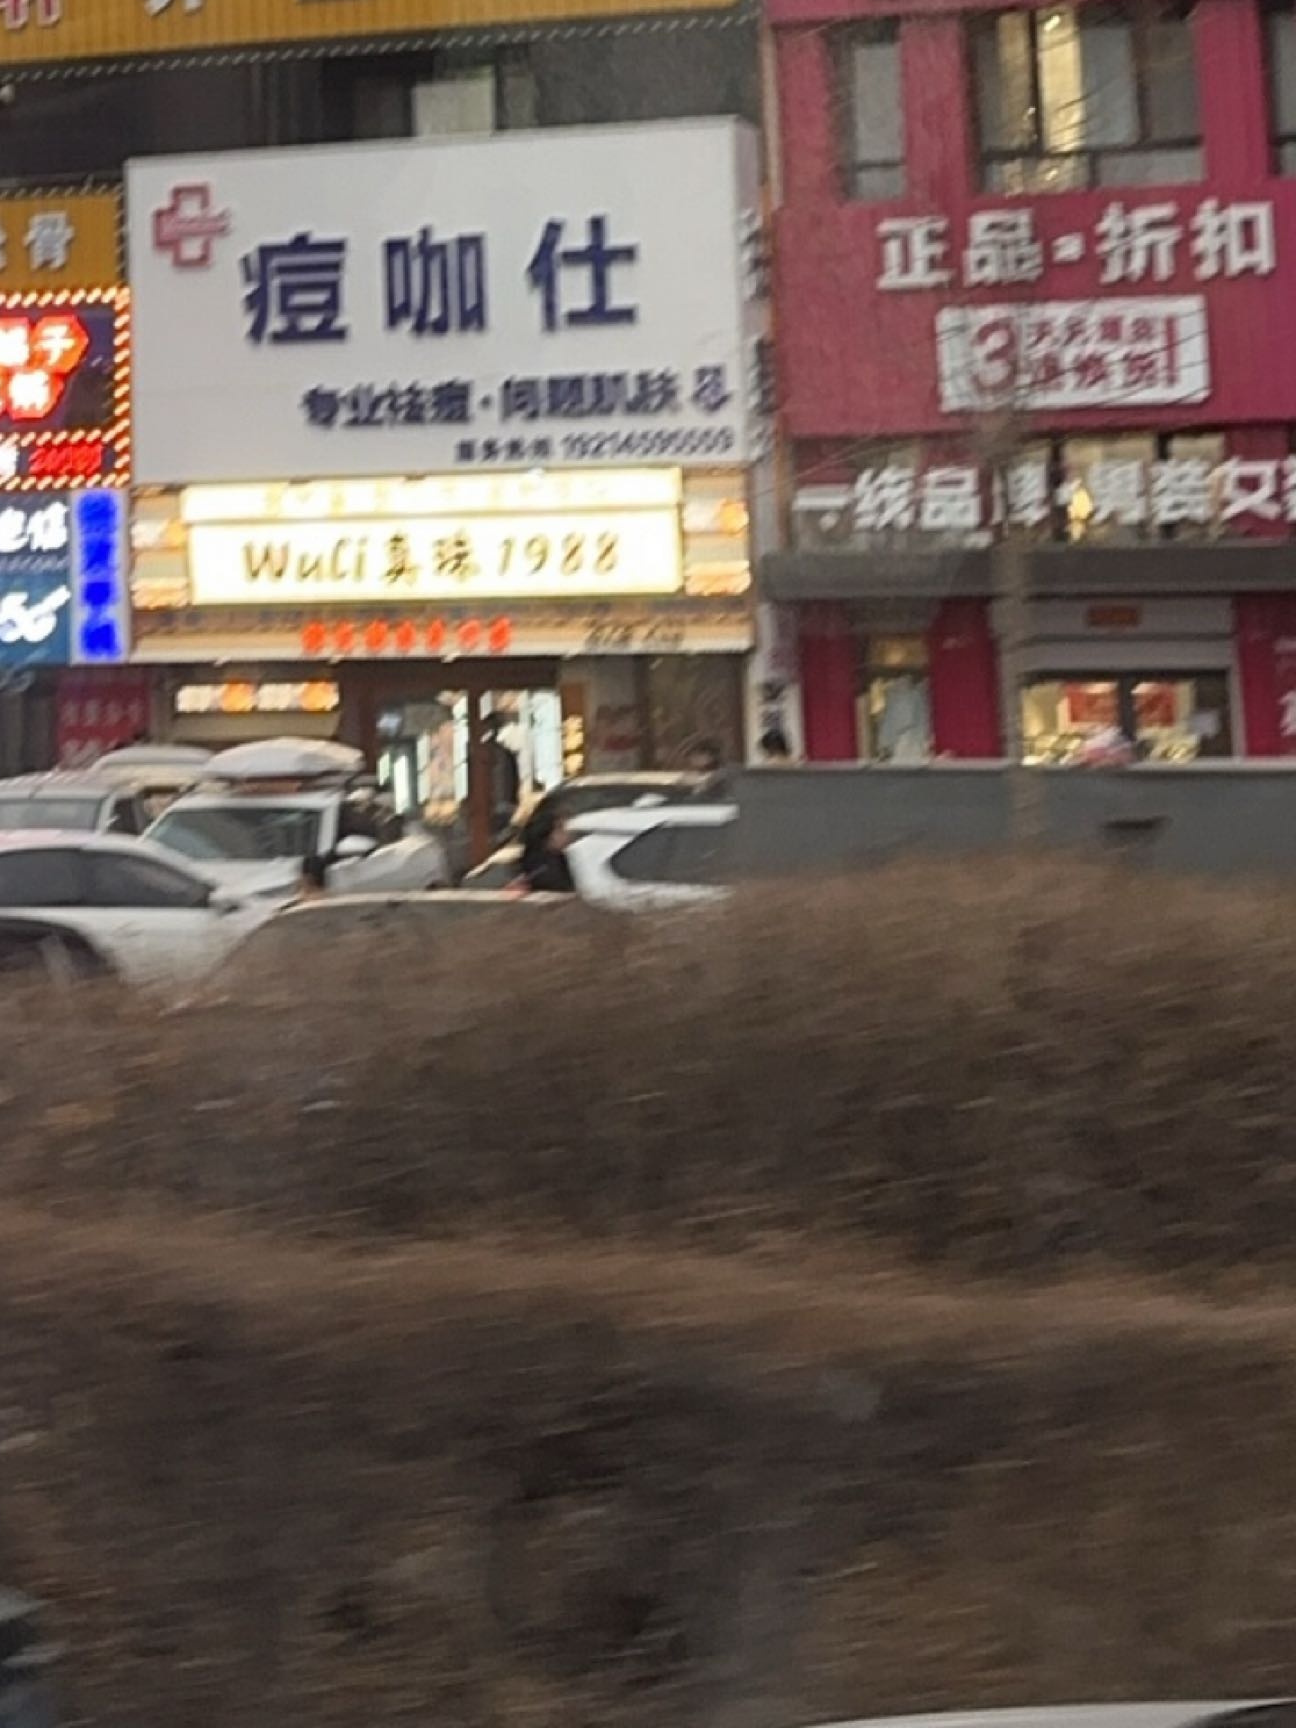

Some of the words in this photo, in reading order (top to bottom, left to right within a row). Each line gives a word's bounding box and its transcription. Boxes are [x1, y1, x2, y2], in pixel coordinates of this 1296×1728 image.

[239, 215, 640, 346] 痘咖仕
[495, 531, 620, 578] 1988
